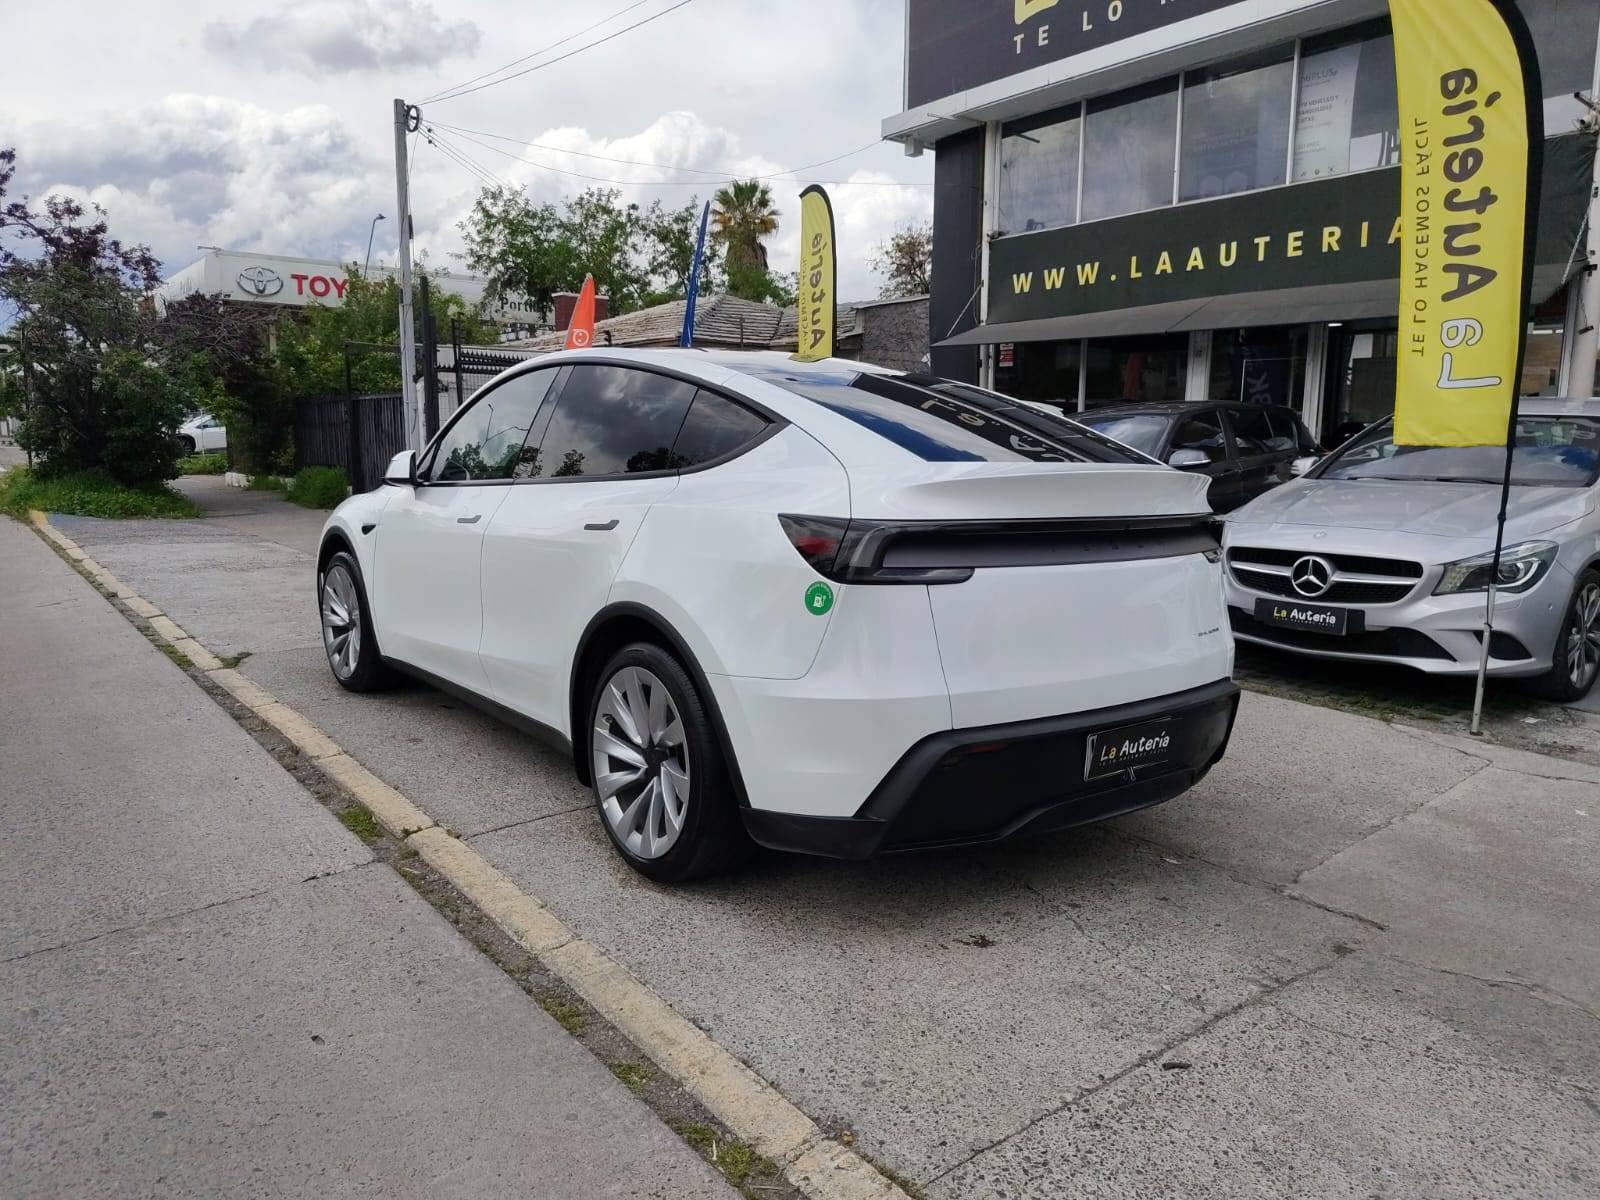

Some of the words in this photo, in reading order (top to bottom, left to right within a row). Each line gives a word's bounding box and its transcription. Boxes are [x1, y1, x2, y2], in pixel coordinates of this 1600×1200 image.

[1013, 25, 1049, 54] TE
[1082, 0, 1123, 32] LO
[290, 273, 352, 299] TOY
[1273, 606, 1287, 617] La
[1290, 608, 1337, 624] Autería
[1100, 745, 1117, 762] La
[1120, 730, 1170, 756] Autería
